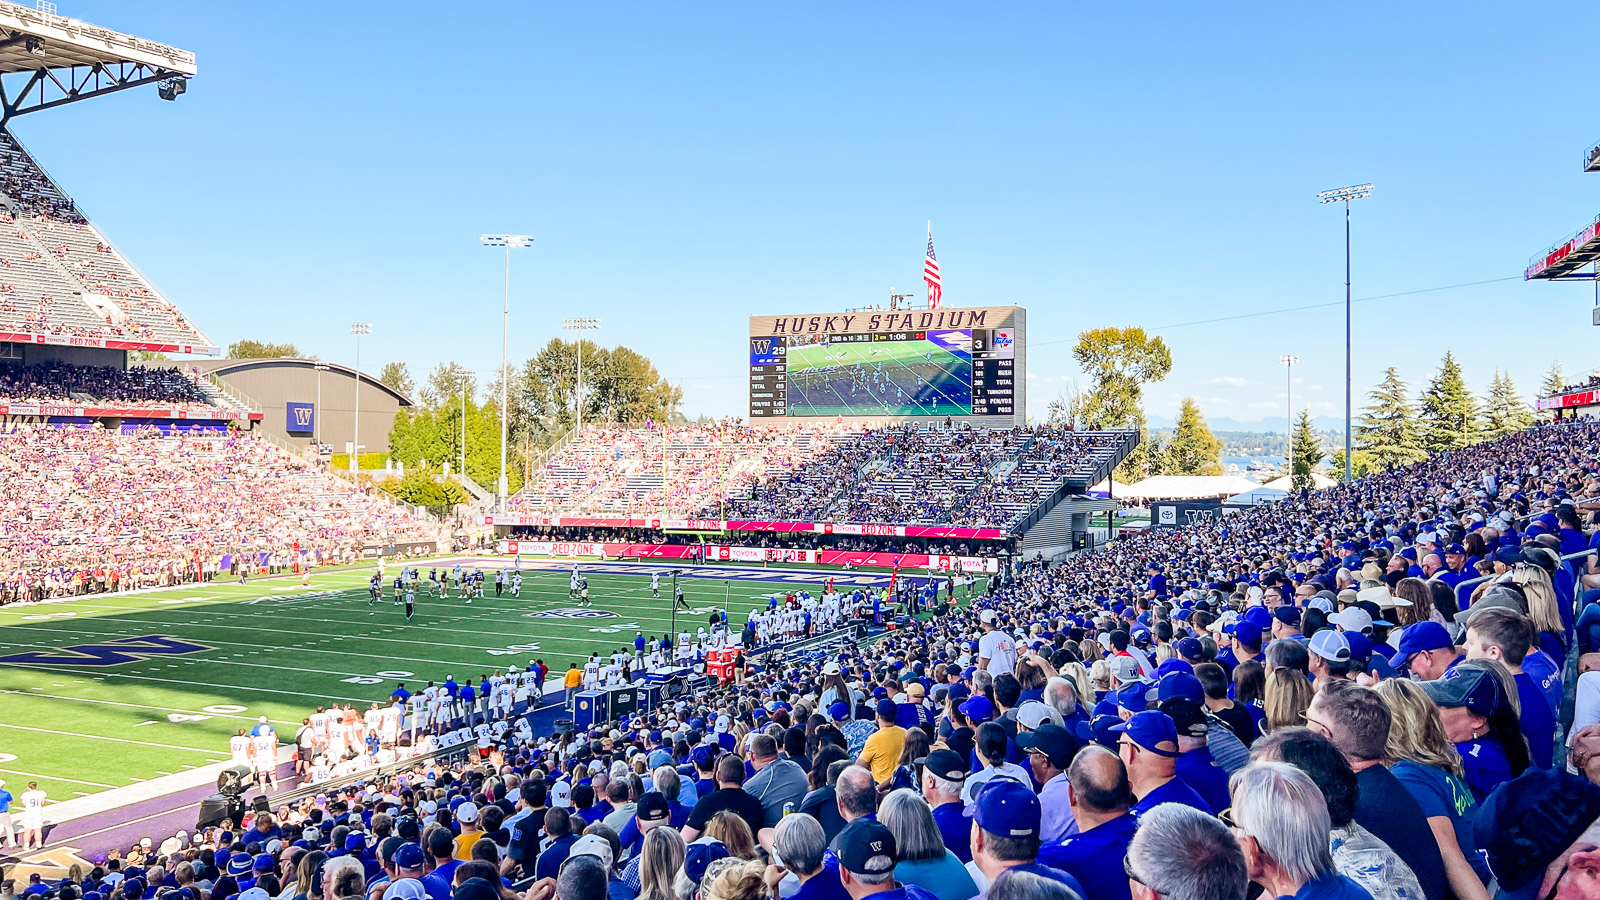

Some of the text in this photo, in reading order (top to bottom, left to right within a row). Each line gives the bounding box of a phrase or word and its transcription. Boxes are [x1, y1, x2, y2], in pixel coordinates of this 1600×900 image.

[773, 311, 988, 333] HUSKY STADIUM
[70, 338, 83, 346] RED
[85, 339, 101, 347] ZONE
[752, 339, 771, 355] W
[975, 340, 983, 349] 3
[772, 346, 785, 355] 29
[40, 407, 55, 416] RED
[57, 407, 76, 416] ZONE
[212, 411, 225, 419] RED
[226, 412, 242, 420] ZONE
[294, 408, 313, 426] W
[520, 517, 533, 525] RED
[688, 520, 700, 529] RED
[703, 521, 721, 529] ZONE
[861, 525, 876, 535] RED
[878, 526, 897, 535] ZONE
[553, 543, 570, 554] RED
[571, 544, 594, 555] ZONE
[0, 634, 220, 668] W
[726, 666, 733, 677] G
[1128, 669, 1138, 677] W
[258, 743, 269, 751] 52
[1469, 743, 1482, 758] 1
[317, 771, 328, 779] 65
[30, 799, 39, 807] 91
[870, 840, 882, 852] W
